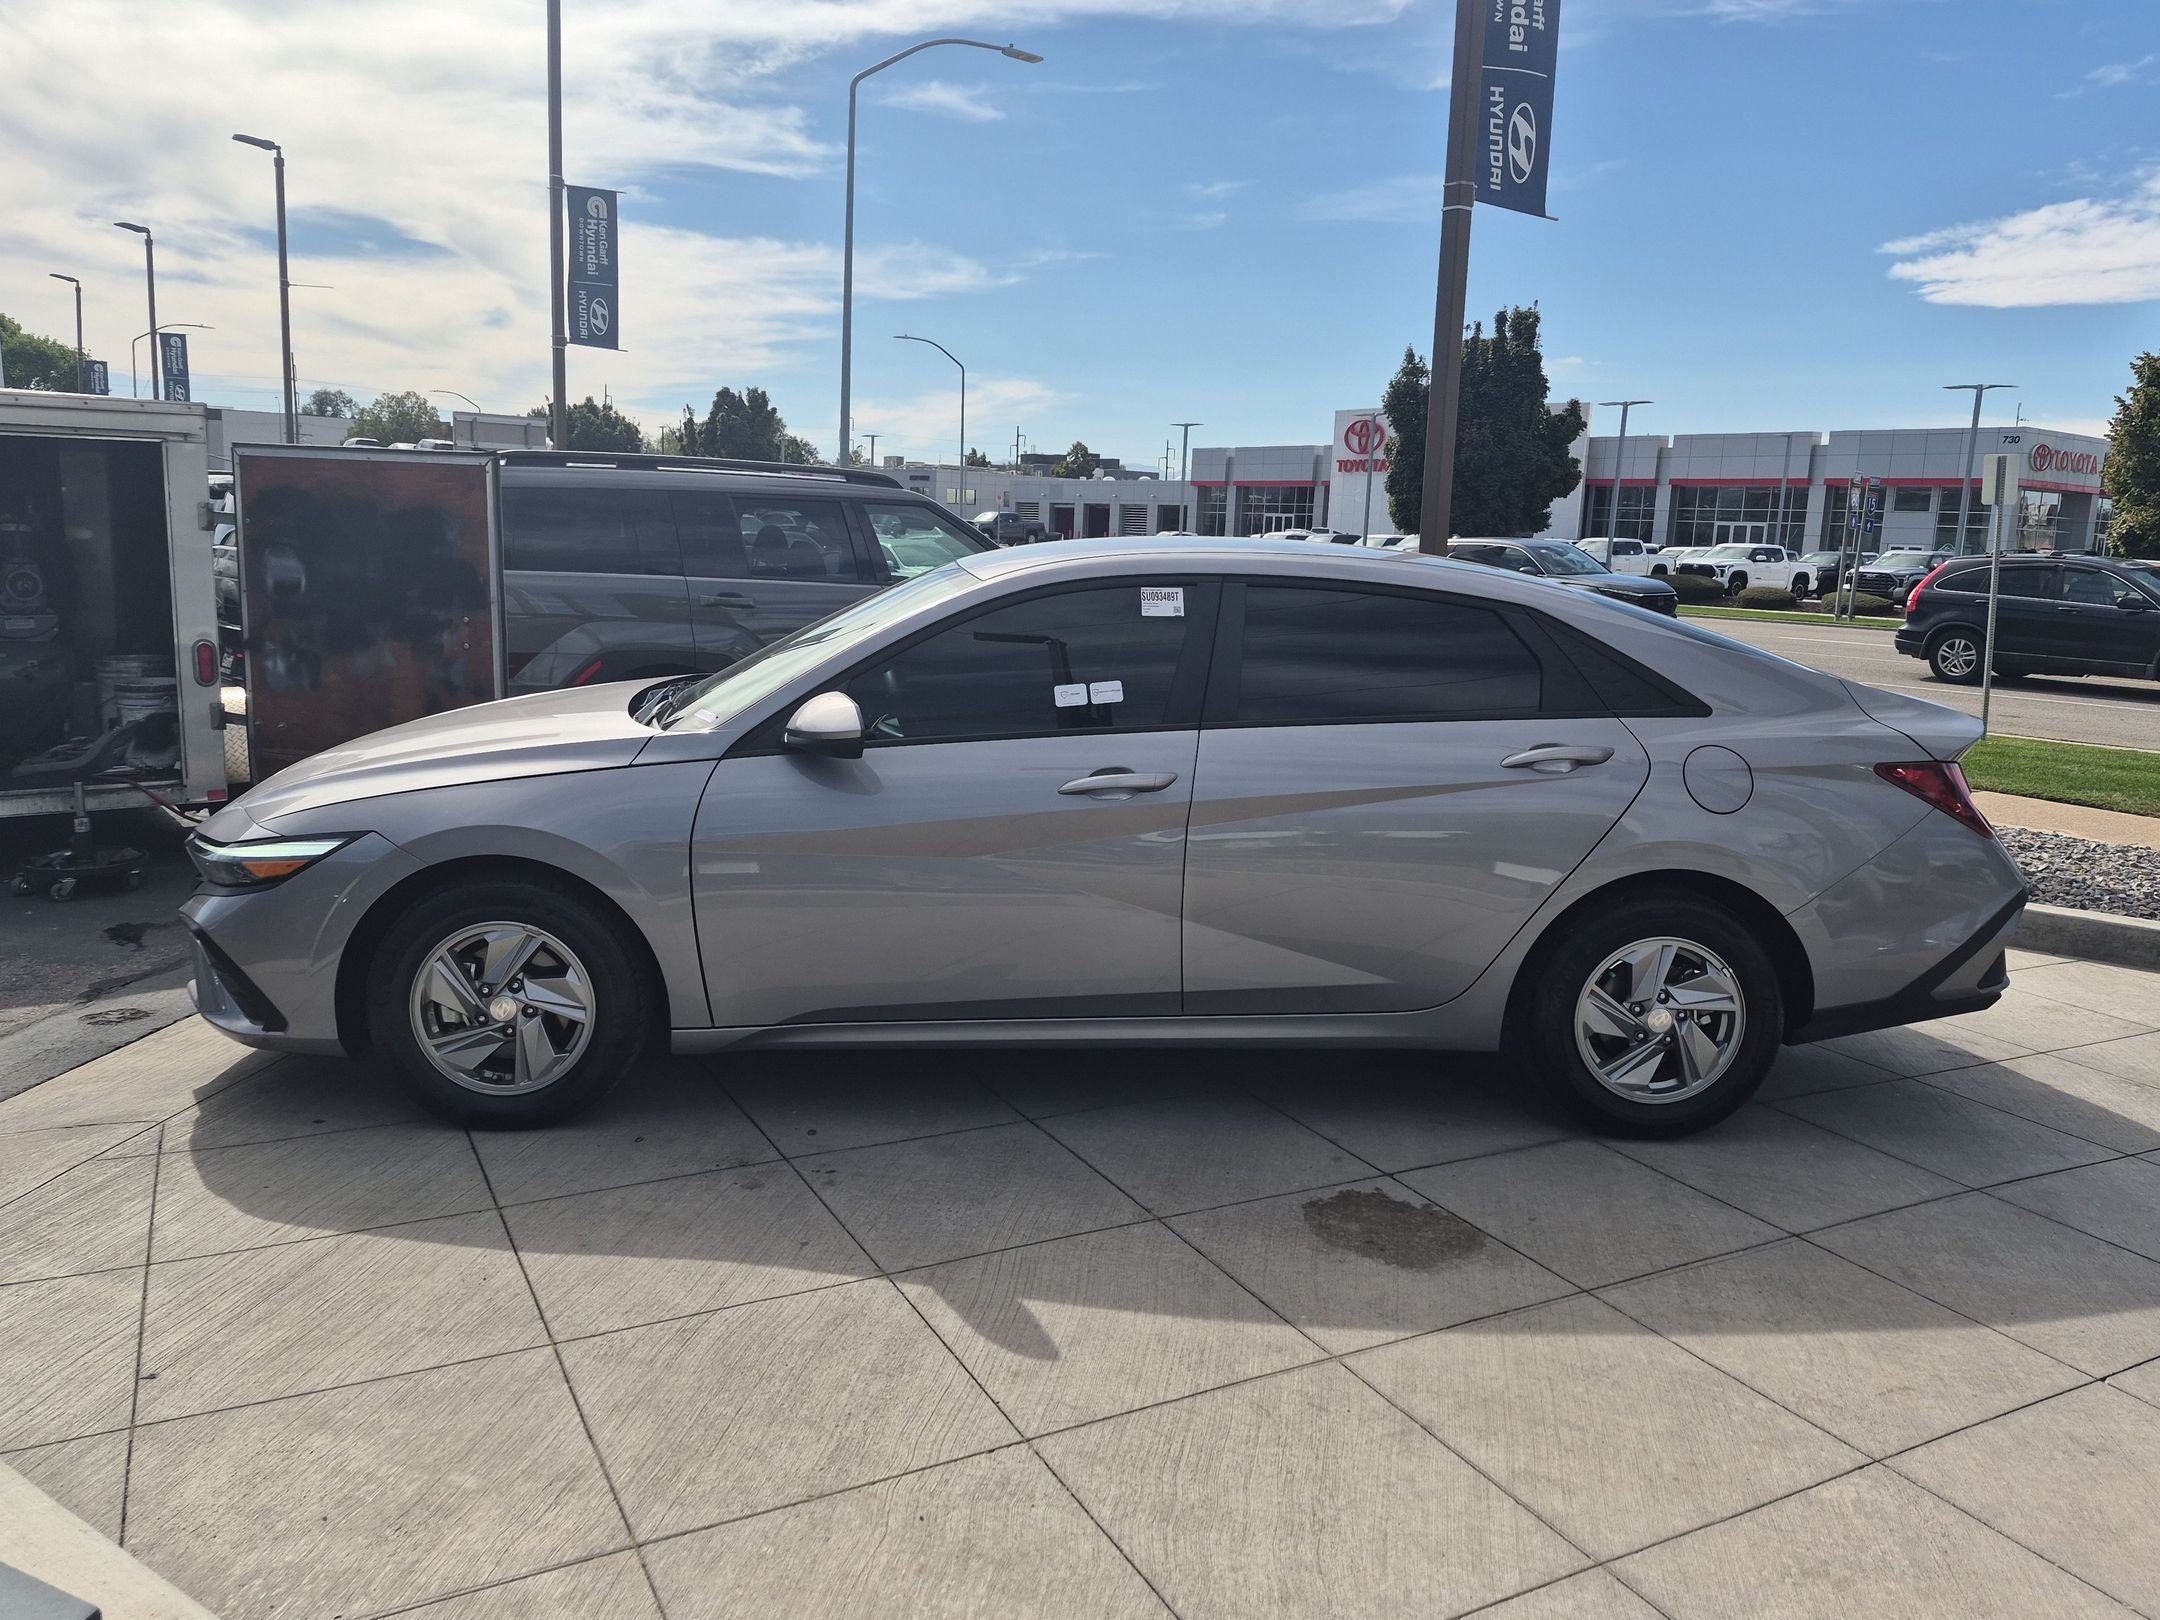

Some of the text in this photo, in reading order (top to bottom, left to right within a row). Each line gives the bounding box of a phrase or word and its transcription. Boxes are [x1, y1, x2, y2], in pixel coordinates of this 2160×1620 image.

[1489, 86, 1505, 191] HYUNDAI
[586, 219, 599, 276] Hyundai
[598, 219, 609, 265] Ken Garff
[578, 290, 588, 339] HYUNDAI
[2002, 435, 2020, 444] 730
[2051, 450, 2097, 474] TOYOTA
[1868, 497, 1876, 511] 15
[1141, 591, 1179, 602] SU093489T
